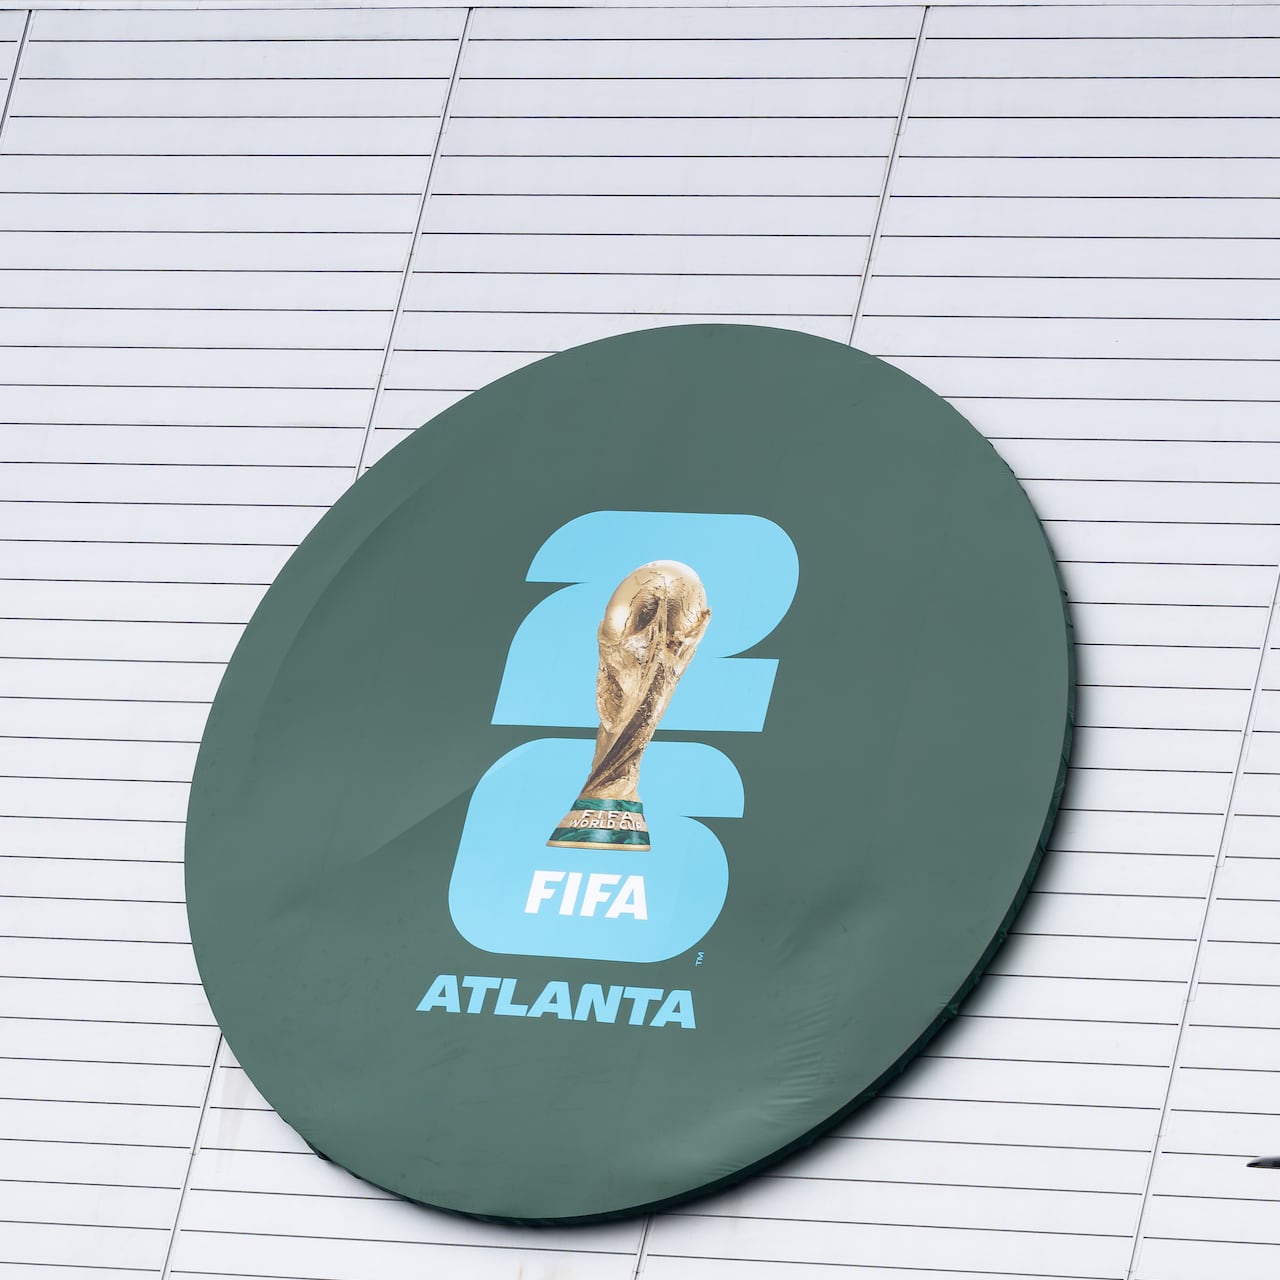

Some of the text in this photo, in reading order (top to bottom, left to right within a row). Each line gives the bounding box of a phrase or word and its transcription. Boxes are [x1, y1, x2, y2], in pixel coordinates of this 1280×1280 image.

[581, 809, 634, 820] FIFA
[569, 818, 643, 831] WORLD CUP
[524, 869, 649, 921] FIFA
[695, 951, 705, 967] TM
[416, 974, 697, 1030] ATLANTA
